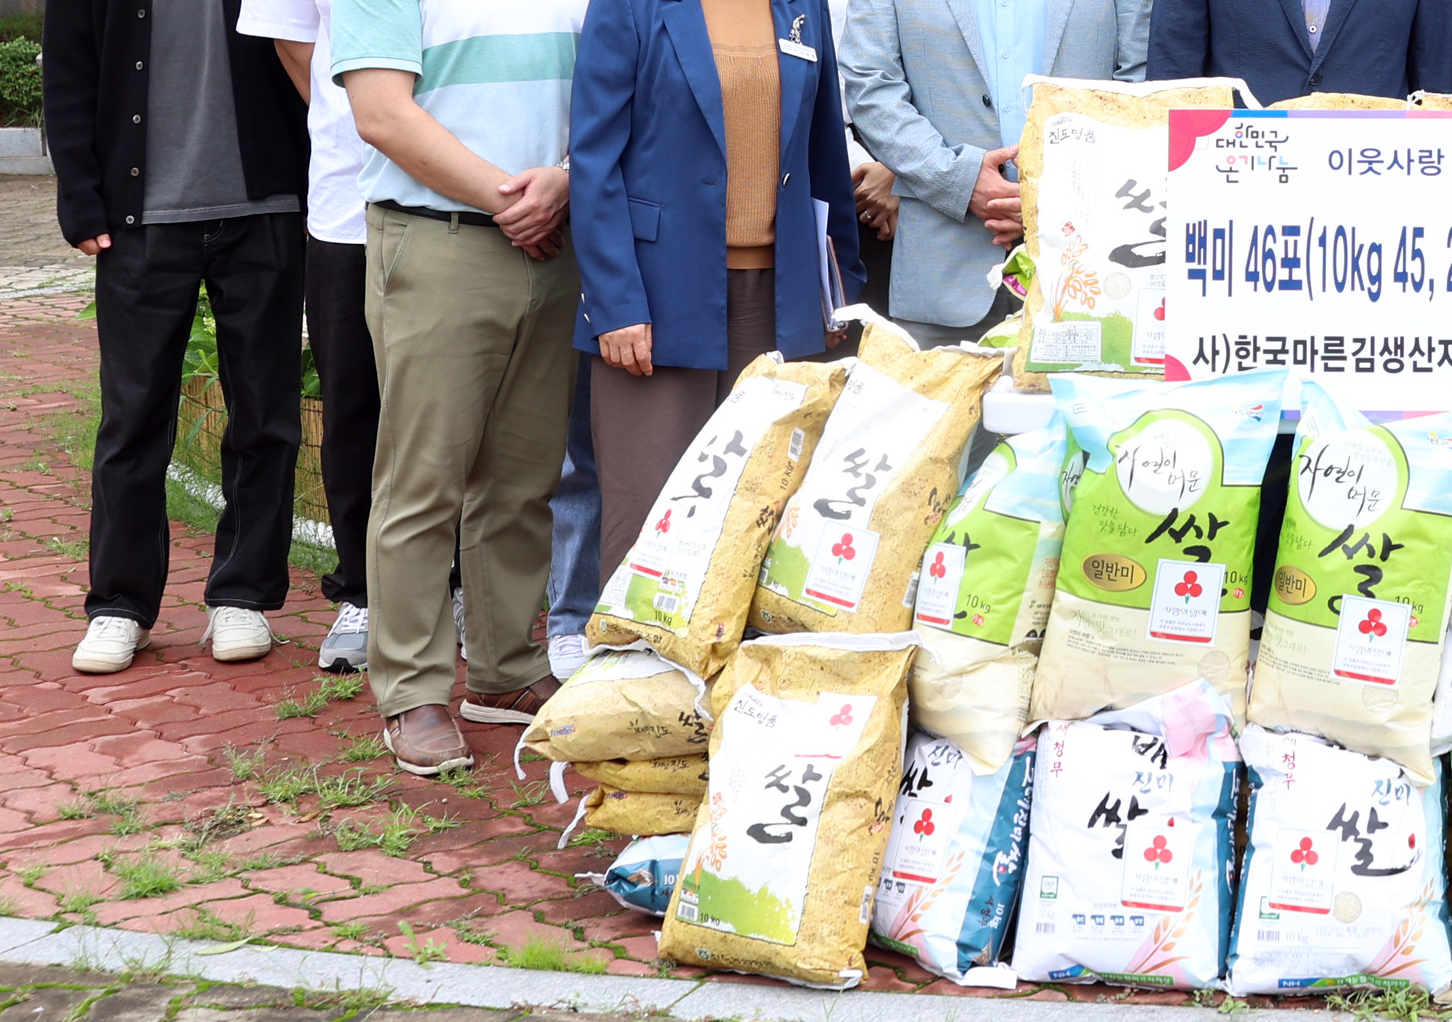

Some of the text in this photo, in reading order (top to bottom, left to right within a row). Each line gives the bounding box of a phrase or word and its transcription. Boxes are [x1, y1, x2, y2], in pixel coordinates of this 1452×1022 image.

[1048, 127, 1097, 144] 진도명품
[1216, 123, 1289, 152] 대한민국
[1216, 155, 1298, 184] 온기나눔
[1328, 148, 1445, 176] 이웃사랑
[1186, 219, 1233, 297] 백미
[1245, 217, 1382, 303] 46포(10kg
[1394, 225, 1434, 302] 45,
[1114, 445, 1176, 492] 자연이
[1299, 444, 1364, 504] 자연이
[813, 447, 893, 520] 쌀
[1347, 488, 1382, 517] 머문
[1091, 559, 1135, 585] 일반미
[1224, 571, 1238, 584] 10
[1278, 569, 1307, 599] 일반미
[1317, 524, 1405, 616] 쌀
[965, 594, 992, 615] 10 kg
[733, 698, 777, 727] 진도명품
[1050, 723, 1070, 778] 새청무
[1132, 771, 1174, 794] 진미
[1371, 779, 1411, 806] 진미
[746, 764, 822, 844] 쌀
[1087, 791, 1149, 859] 쌀
[1326, 802, 1422, 877] 쌀
[664, 874, 674, 885] 10
[995, 903, 1005, 915] 10
